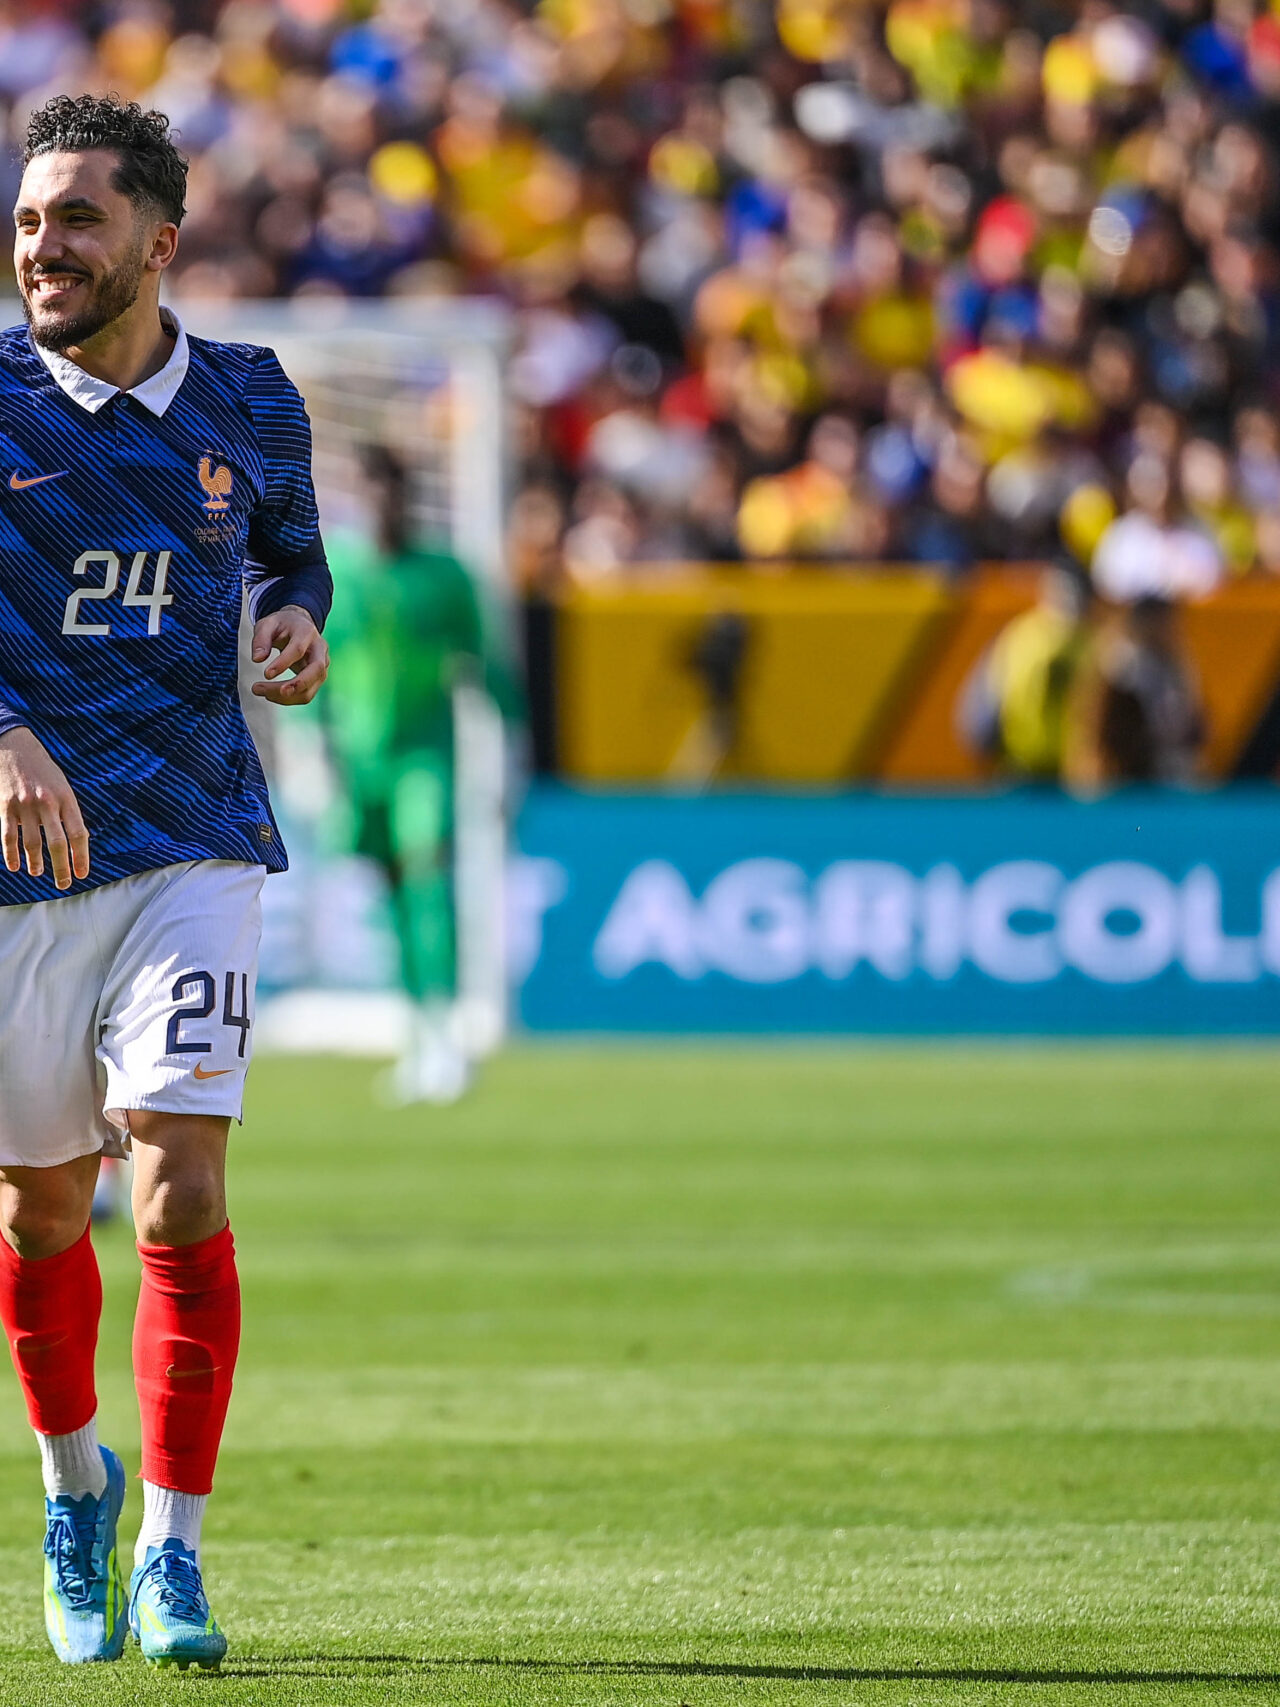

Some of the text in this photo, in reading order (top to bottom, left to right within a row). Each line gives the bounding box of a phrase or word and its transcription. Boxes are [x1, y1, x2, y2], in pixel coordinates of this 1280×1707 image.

[62, 550, 174, 635] 24
[593, 858, 1280, 984] AGRICOL
[166, 970, 250, 1058] 24
